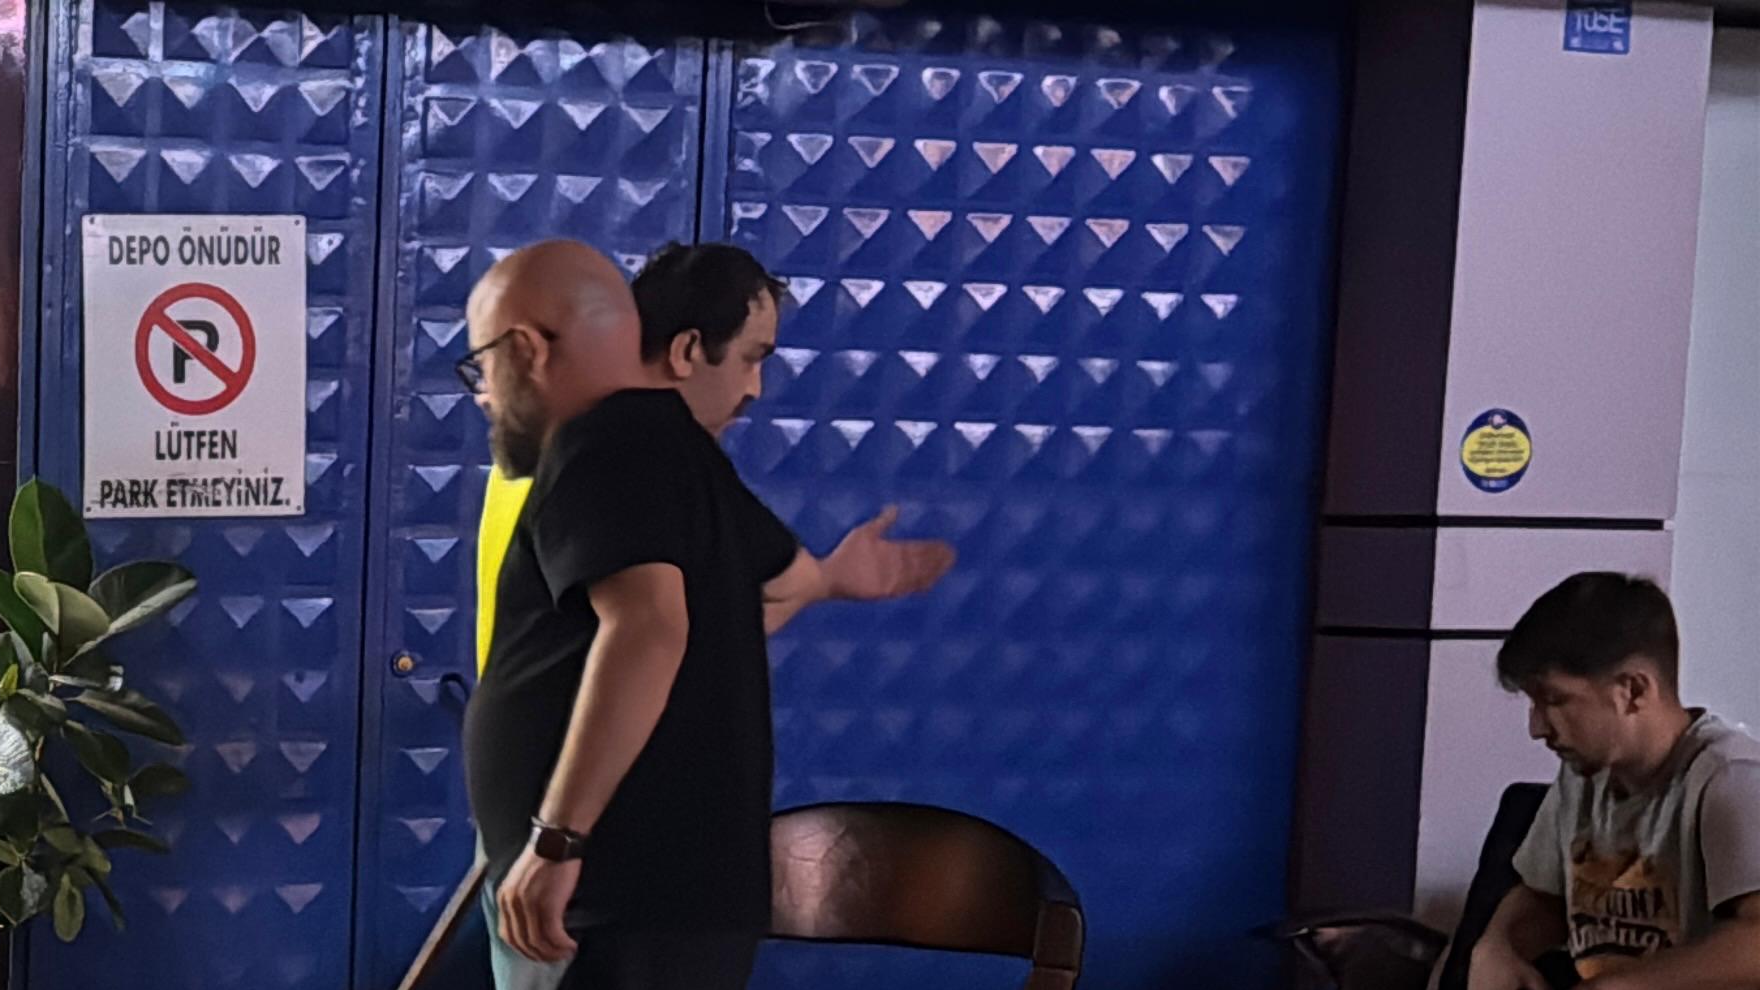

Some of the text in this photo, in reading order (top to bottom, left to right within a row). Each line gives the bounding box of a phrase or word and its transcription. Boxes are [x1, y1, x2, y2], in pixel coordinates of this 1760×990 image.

[108, 226, 281, 266] DEPO ÖNÜDÜR
[154, 421, 238, 460] LÜTFEN
[99, 479, 159, 508] PARK
